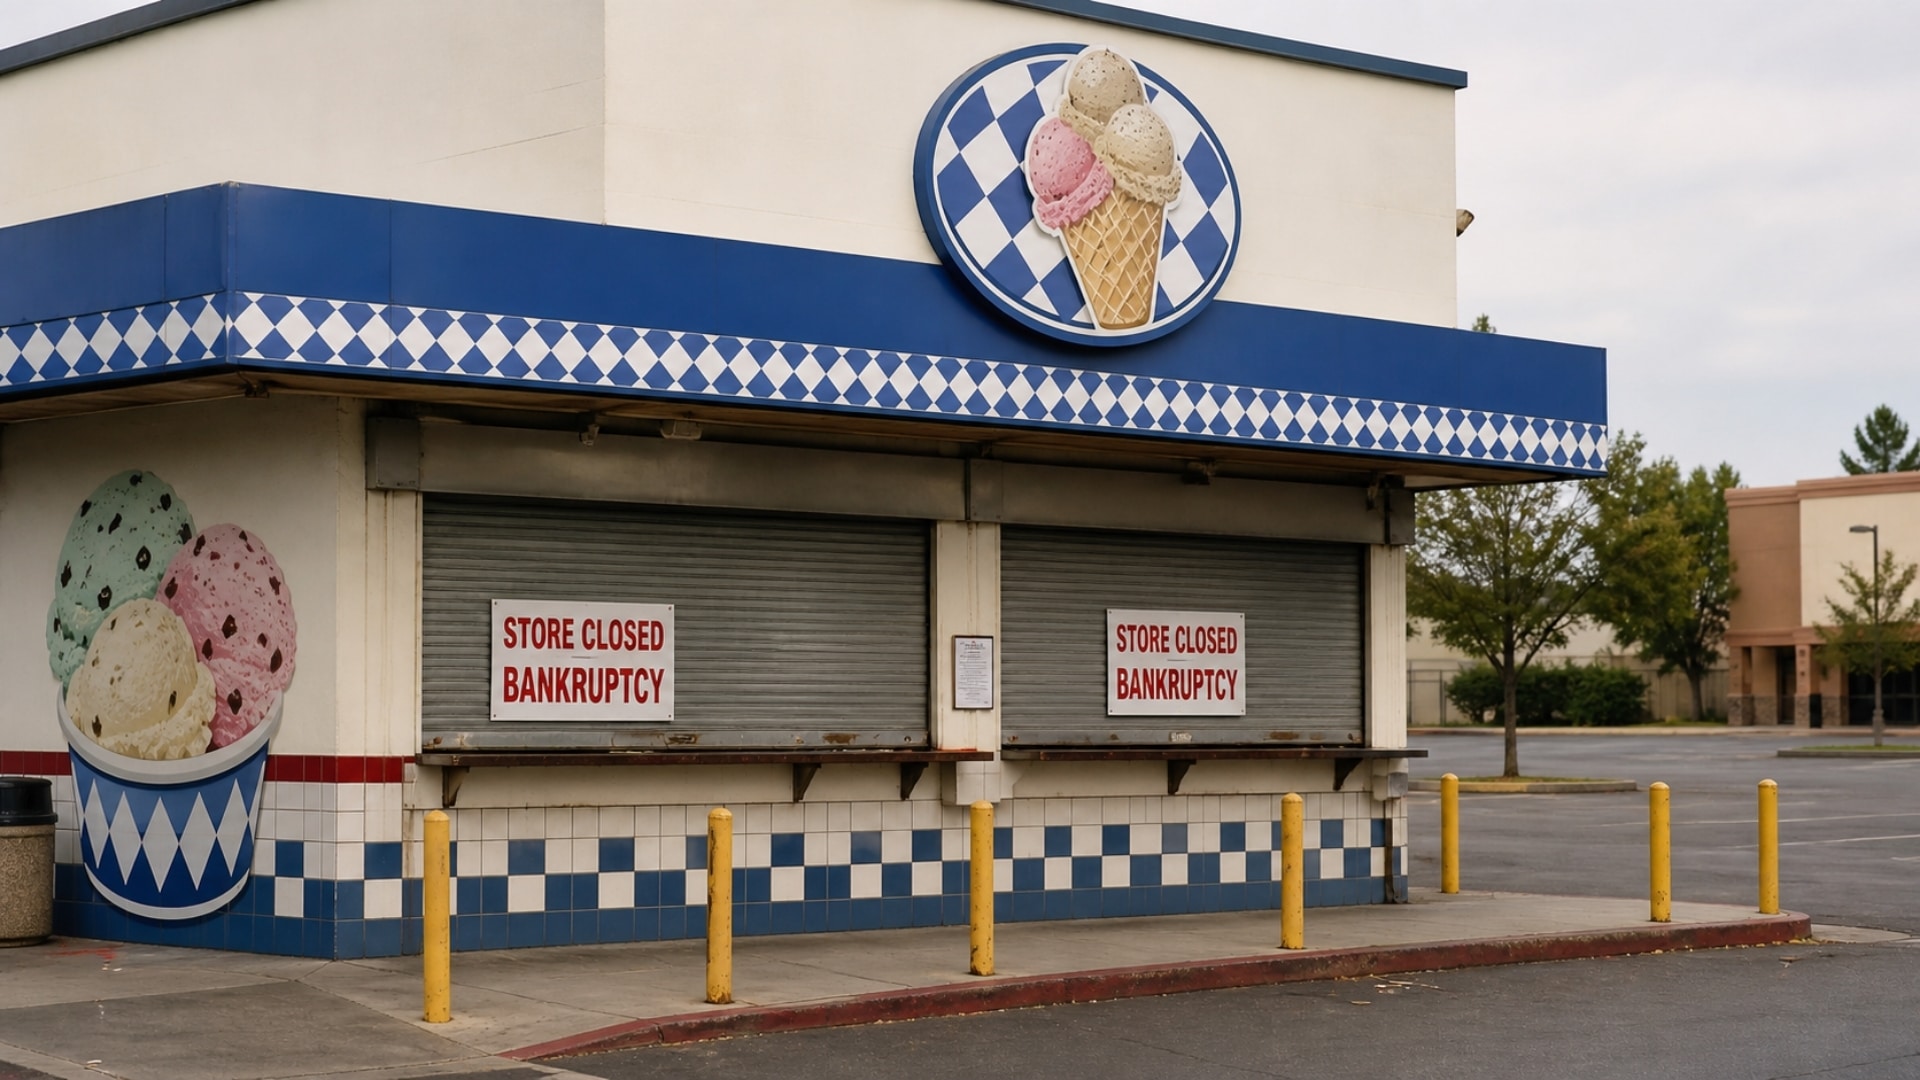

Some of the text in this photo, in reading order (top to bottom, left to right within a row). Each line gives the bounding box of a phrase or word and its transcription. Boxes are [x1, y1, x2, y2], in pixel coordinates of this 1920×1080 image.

[503, 616, 665, 652] STORE CLOSED
[1116, 623, 1238, 655] STORE CLOSED
[503, 665, 665, 704] BANKRUPTCY
[1117, 667, 1238, 701] BANKRUPTCY
